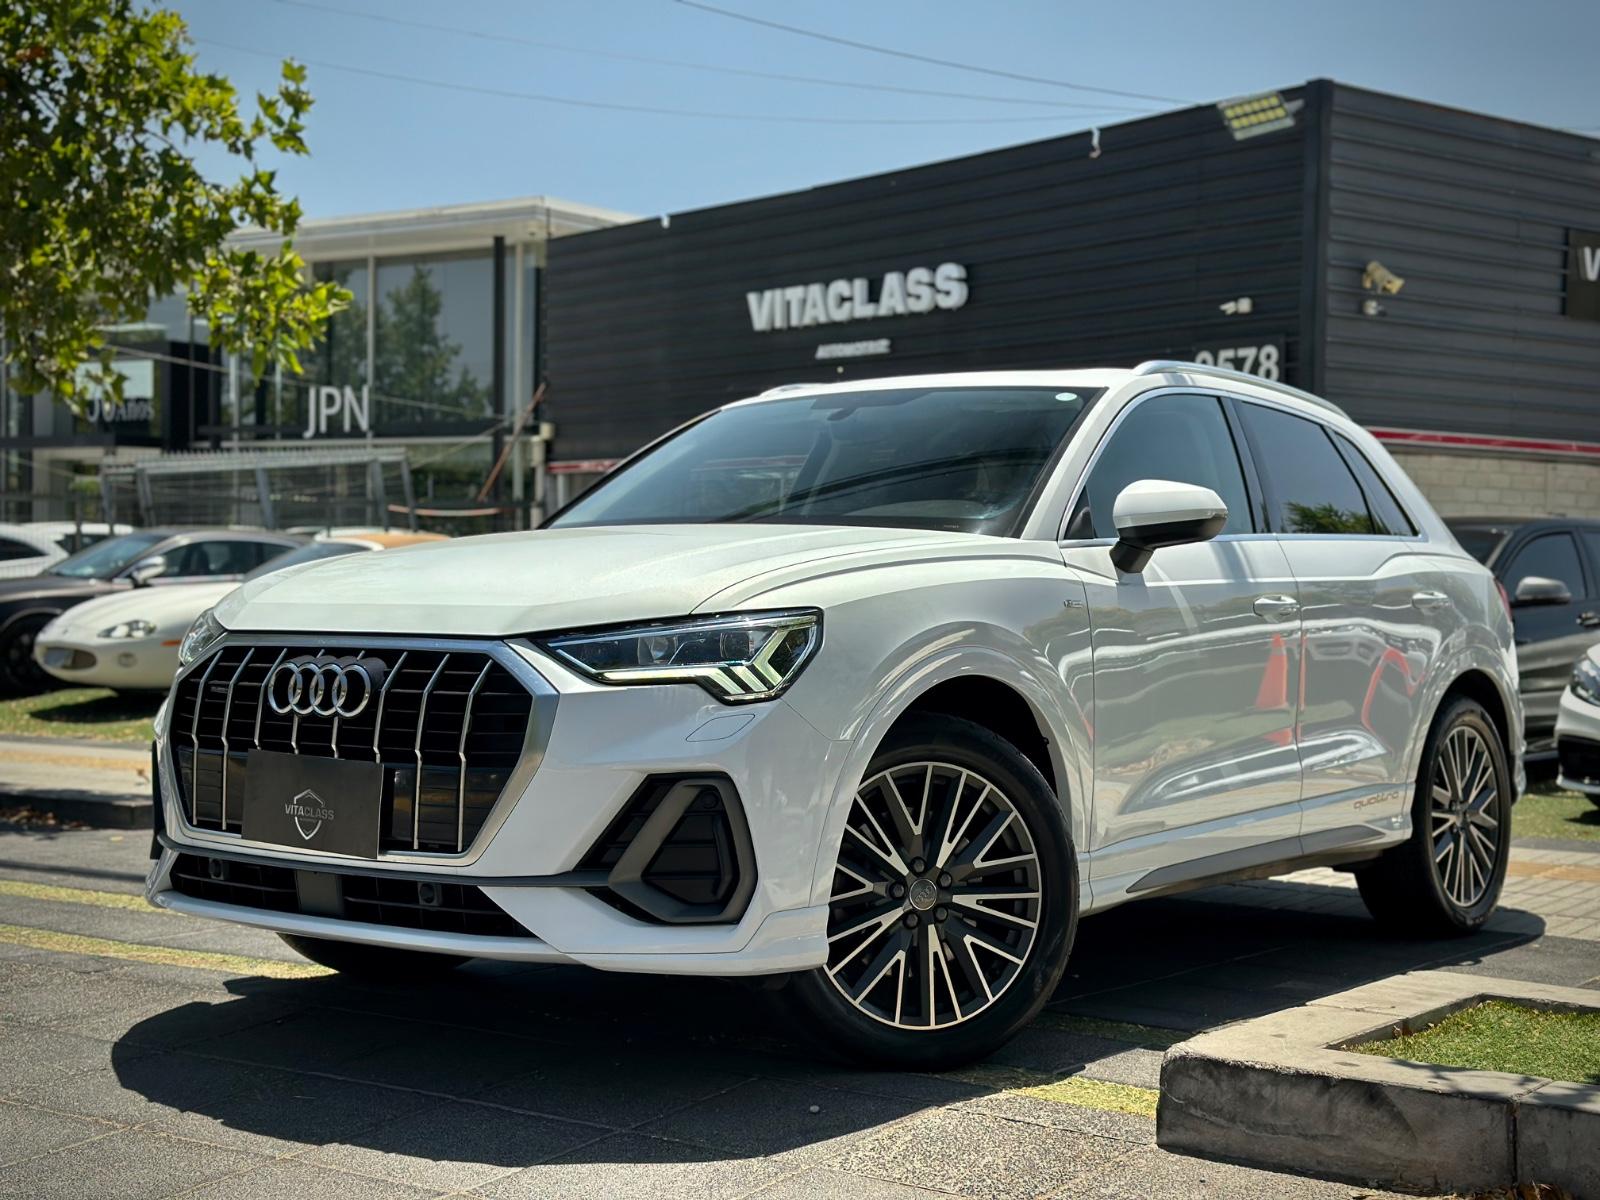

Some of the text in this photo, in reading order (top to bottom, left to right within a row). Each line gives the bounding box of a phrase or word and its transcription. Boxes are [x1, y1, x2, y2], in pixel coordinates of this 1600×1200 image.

[746, 262, 969, 332] VITACLASS
[302, 384, 369, 440] JPN
[284, 802, 335, 821] VITACLASS
[1353, 791, 1400, 811] quattro
